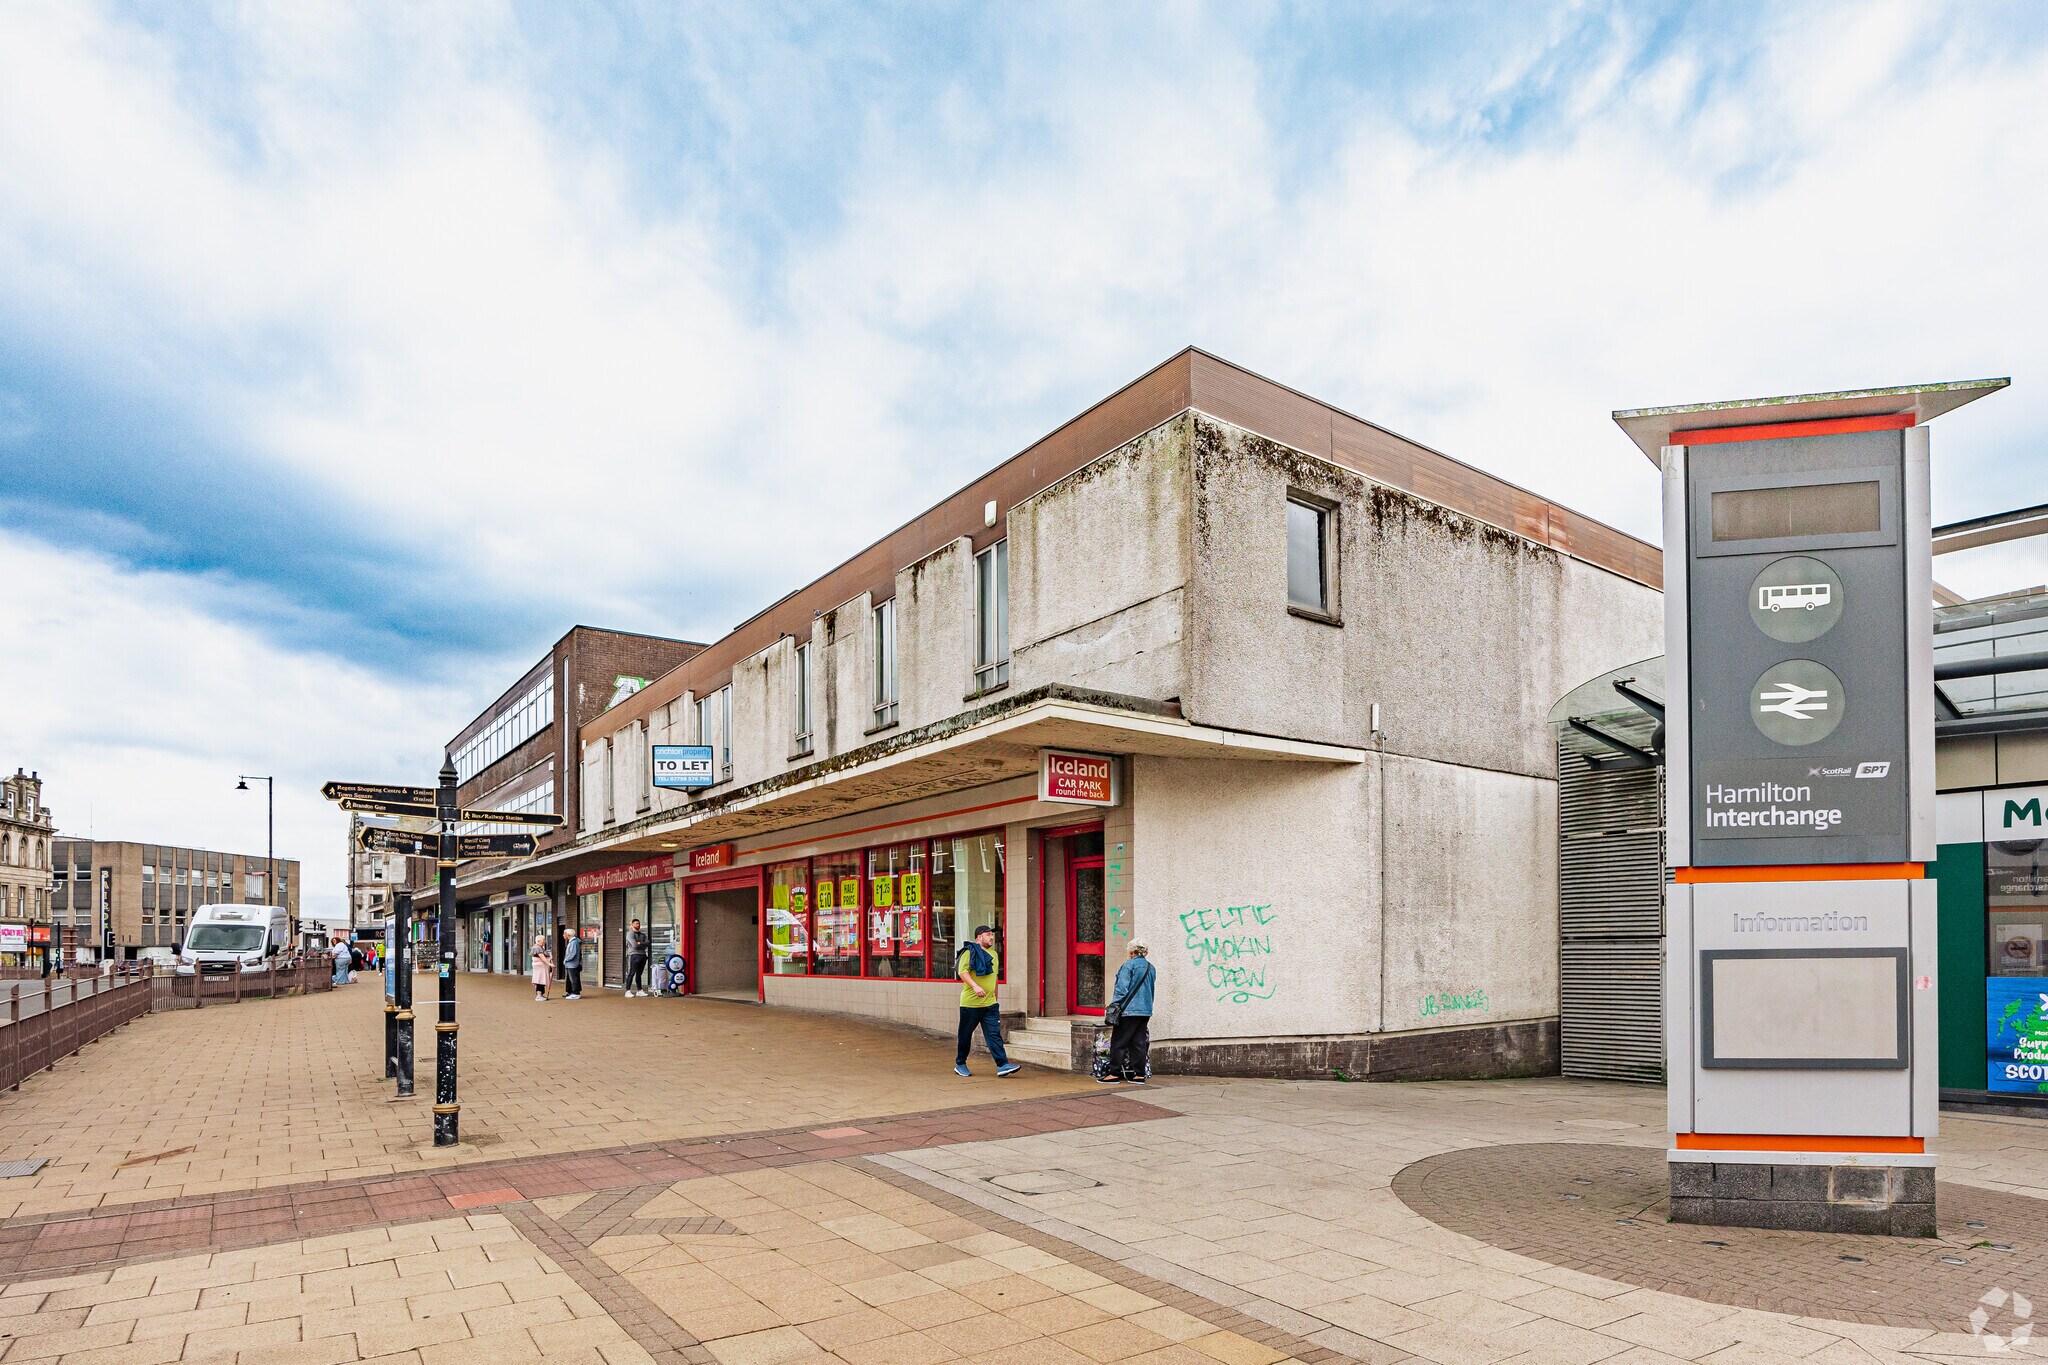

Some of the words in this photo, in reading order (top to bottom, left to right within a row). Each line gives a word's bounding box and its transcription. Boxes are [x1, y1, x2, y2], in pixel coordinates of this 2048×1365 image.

[657, 761, 677, 770] TO
[682, 761, 710, 770] LET
[1051, 756, 1108, 779] Iceland
[1821, 767, 1852, 775] ScotRail
[1862, 765, 1887, 774] SPT
[337, 784, 356, 792] Regent
[357, 785, 382, 793] Shopping
[382, 787, 401, 795] Centre
[1058, 778, 1077, 789] CAR
[1079, 779, 1102, 791] PARK
[1706, 781, 1811, 805] Hamilton
[1056, 788, 1076, 797] round
[1077, 790, 1088, 798] the
[1089, 790, 1105, 799] back
[352, 802, 374, 810] Brandon
[2003, 798, 2048, 828] M
[1706, 805, 1842, 831] Interchange
[695, 850, 720, 867] Iceland
[590, 873, 606, 889] Charity
[606, 869, 628, 885] Furniture
[628, 864, 658, 881] Showroom
[843, 883, 855, 894] HALF
[906, 885, 917, 903] £5
[820, 892, 832, 908] £10
[843, 895, 855, 906] PRICE
[1179, 903, 1279, 933] CELTIC
[1733, 911, 1868, 933] Information
[1186, 931, 1271, 968] SMOKIN
[1207, 964, 1267, 989] CREW
